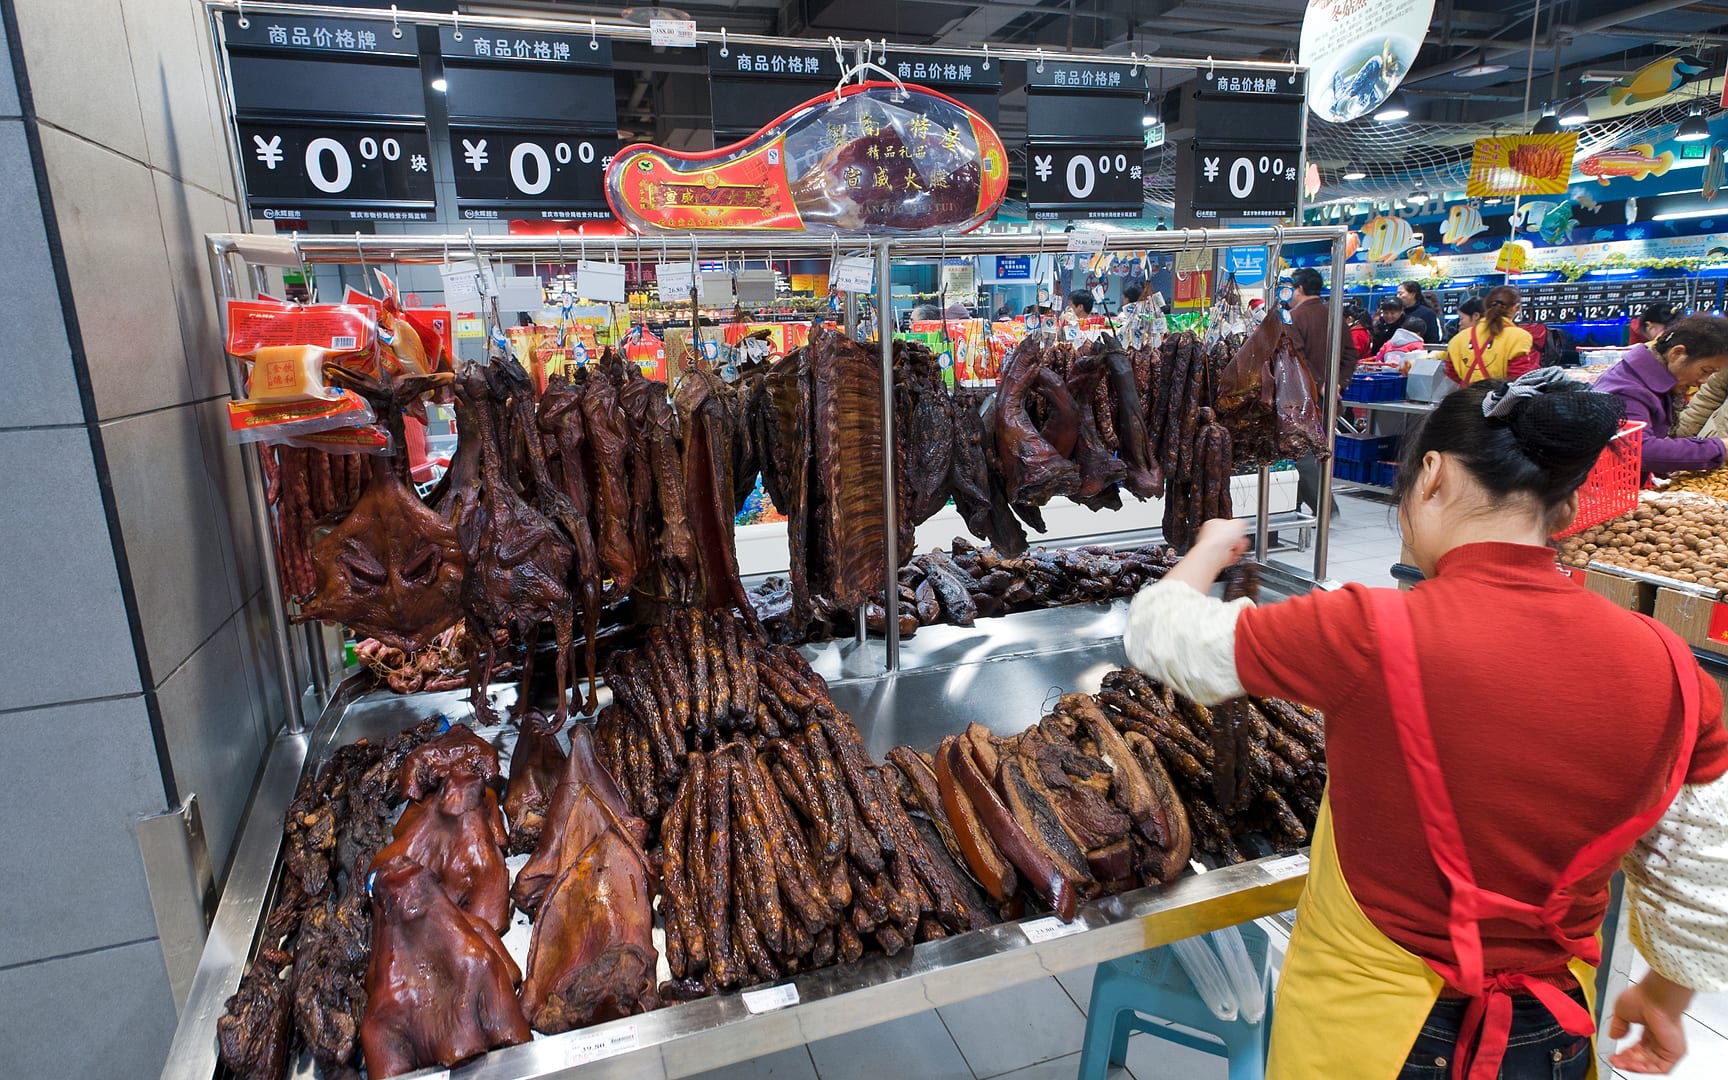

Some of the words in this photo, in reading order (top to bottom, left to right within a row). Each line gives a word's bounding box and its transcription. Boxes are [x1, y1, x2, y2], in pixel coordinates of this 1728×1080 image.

[267, 25, 377, 50] 商品价格牌
[474, 37, 571, 60] 商品价格牌
[737, 54, 820, 74] 商品价格牌
[898, 63, 973, 81] 商品价格牌
[1053, 70, 1121, 86] 商品价格牌
[1217, 77, 1277, 92] 商品价格牌
[866, 144, 927, 160] 精品礼品
[410, 154, 428, 172] 块
[1130, 165, 1142, 179] 袋
[843, 166, 951, 191] 宣威火腿
[1285, 167, 1296, 181] 袋
